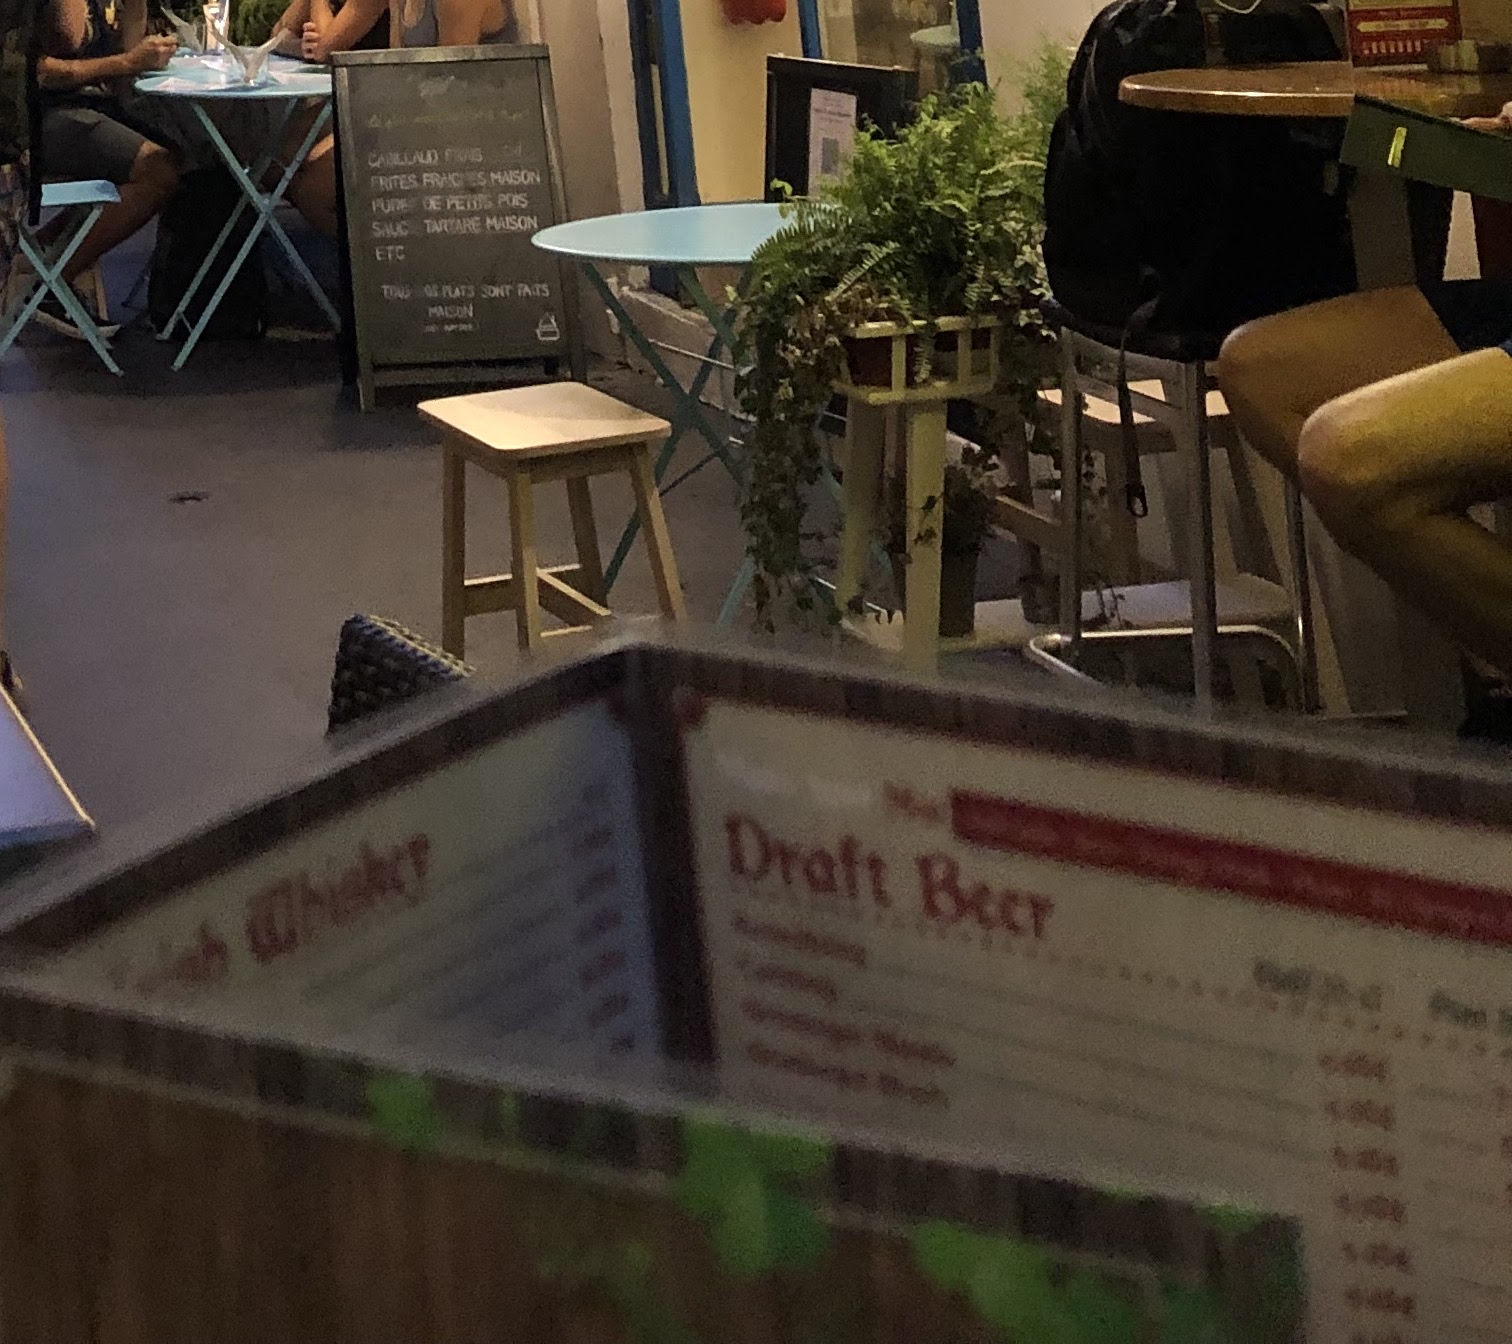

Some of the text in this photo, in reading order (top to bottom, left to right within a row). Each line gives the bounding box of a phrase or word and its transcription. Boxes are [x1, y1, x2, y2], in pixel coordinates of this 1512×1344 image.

[490, 170, 541, 185] MAISON
[485, 215, 538, 231] MAISON
[724, 814, 1057, 941] Draft Beer
